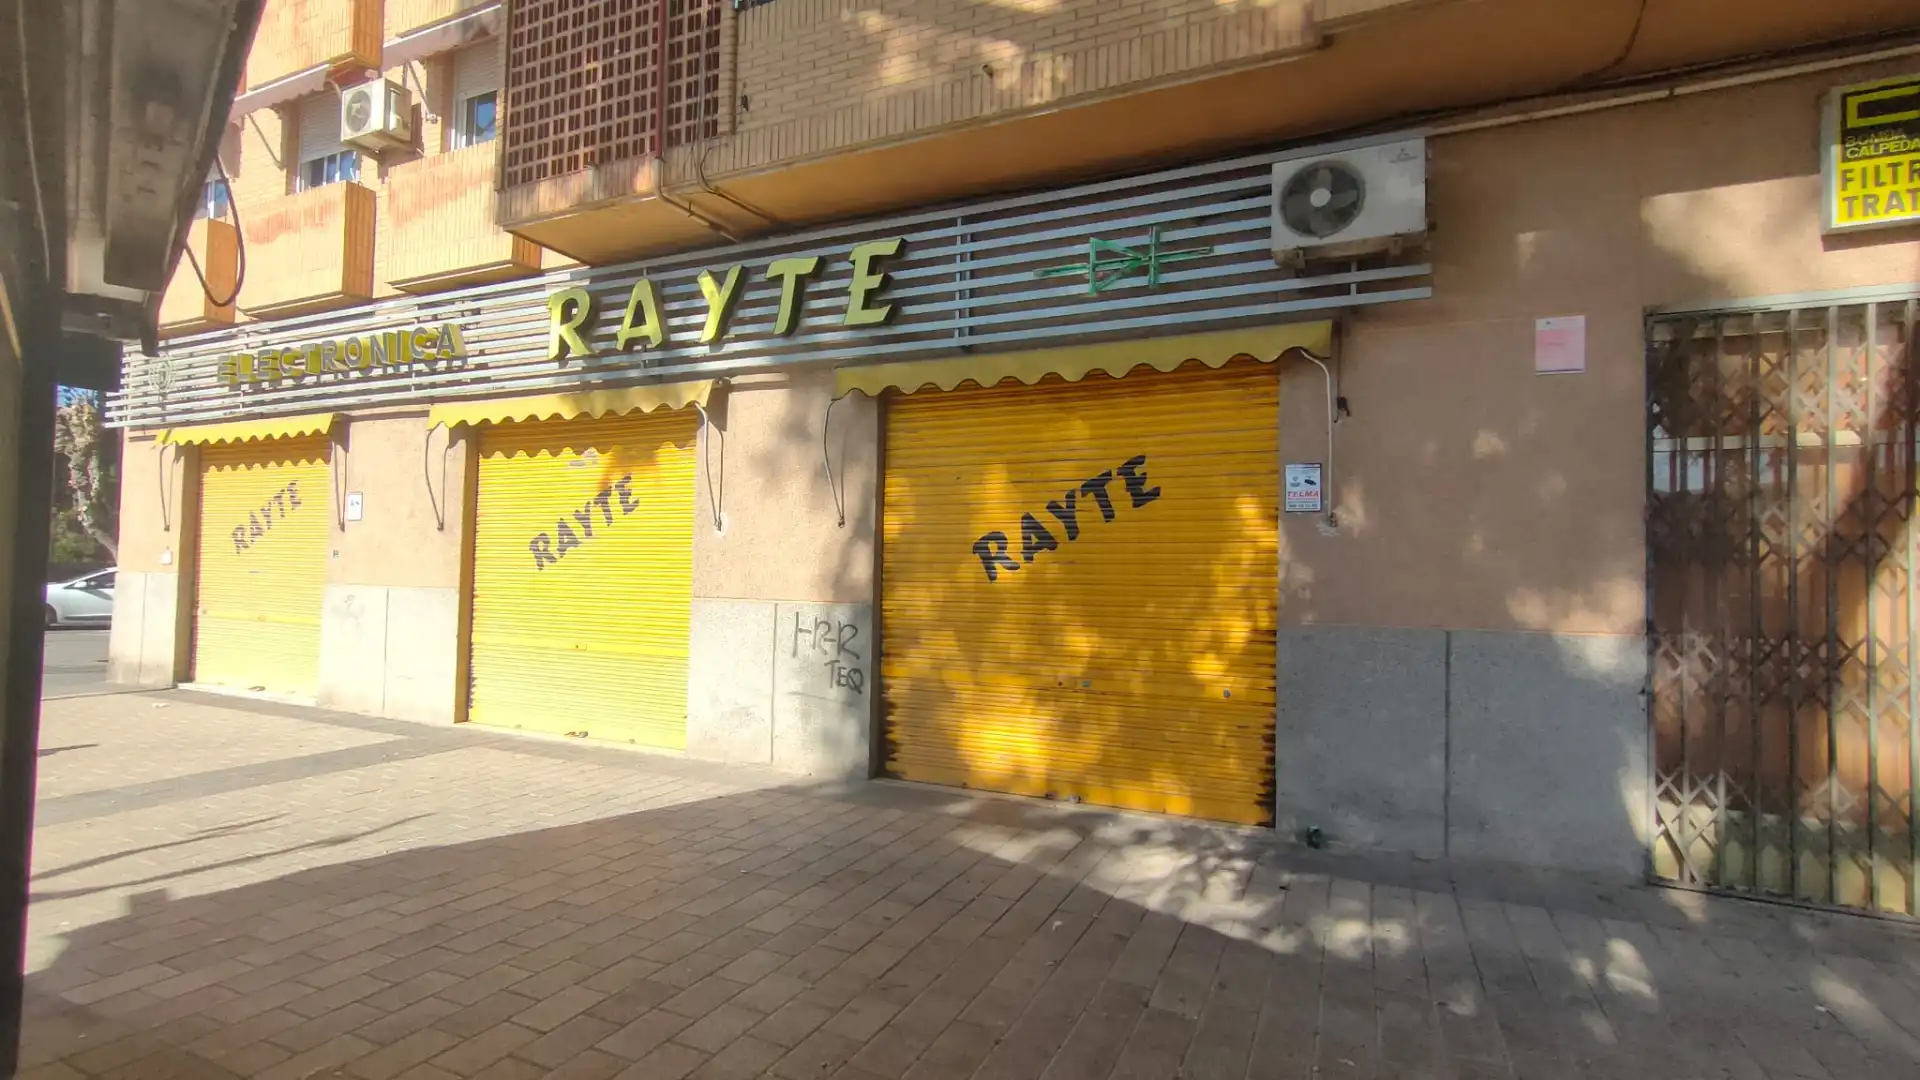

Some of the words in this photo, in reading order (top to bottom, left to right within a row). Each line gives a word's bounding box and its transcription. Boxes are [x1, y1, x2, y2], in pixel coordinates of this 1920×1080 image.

[1846, 138, 1920, 159] CALPEDA
[217, 323, 466, 384] ELECTRONICA
[548, 237, 905, 360] RAYTE
[231, 479, 302, 554] RAYTE
[529, 472, 640, 571] RAYTE
[972, 454, 1161, 583] RAYTE
